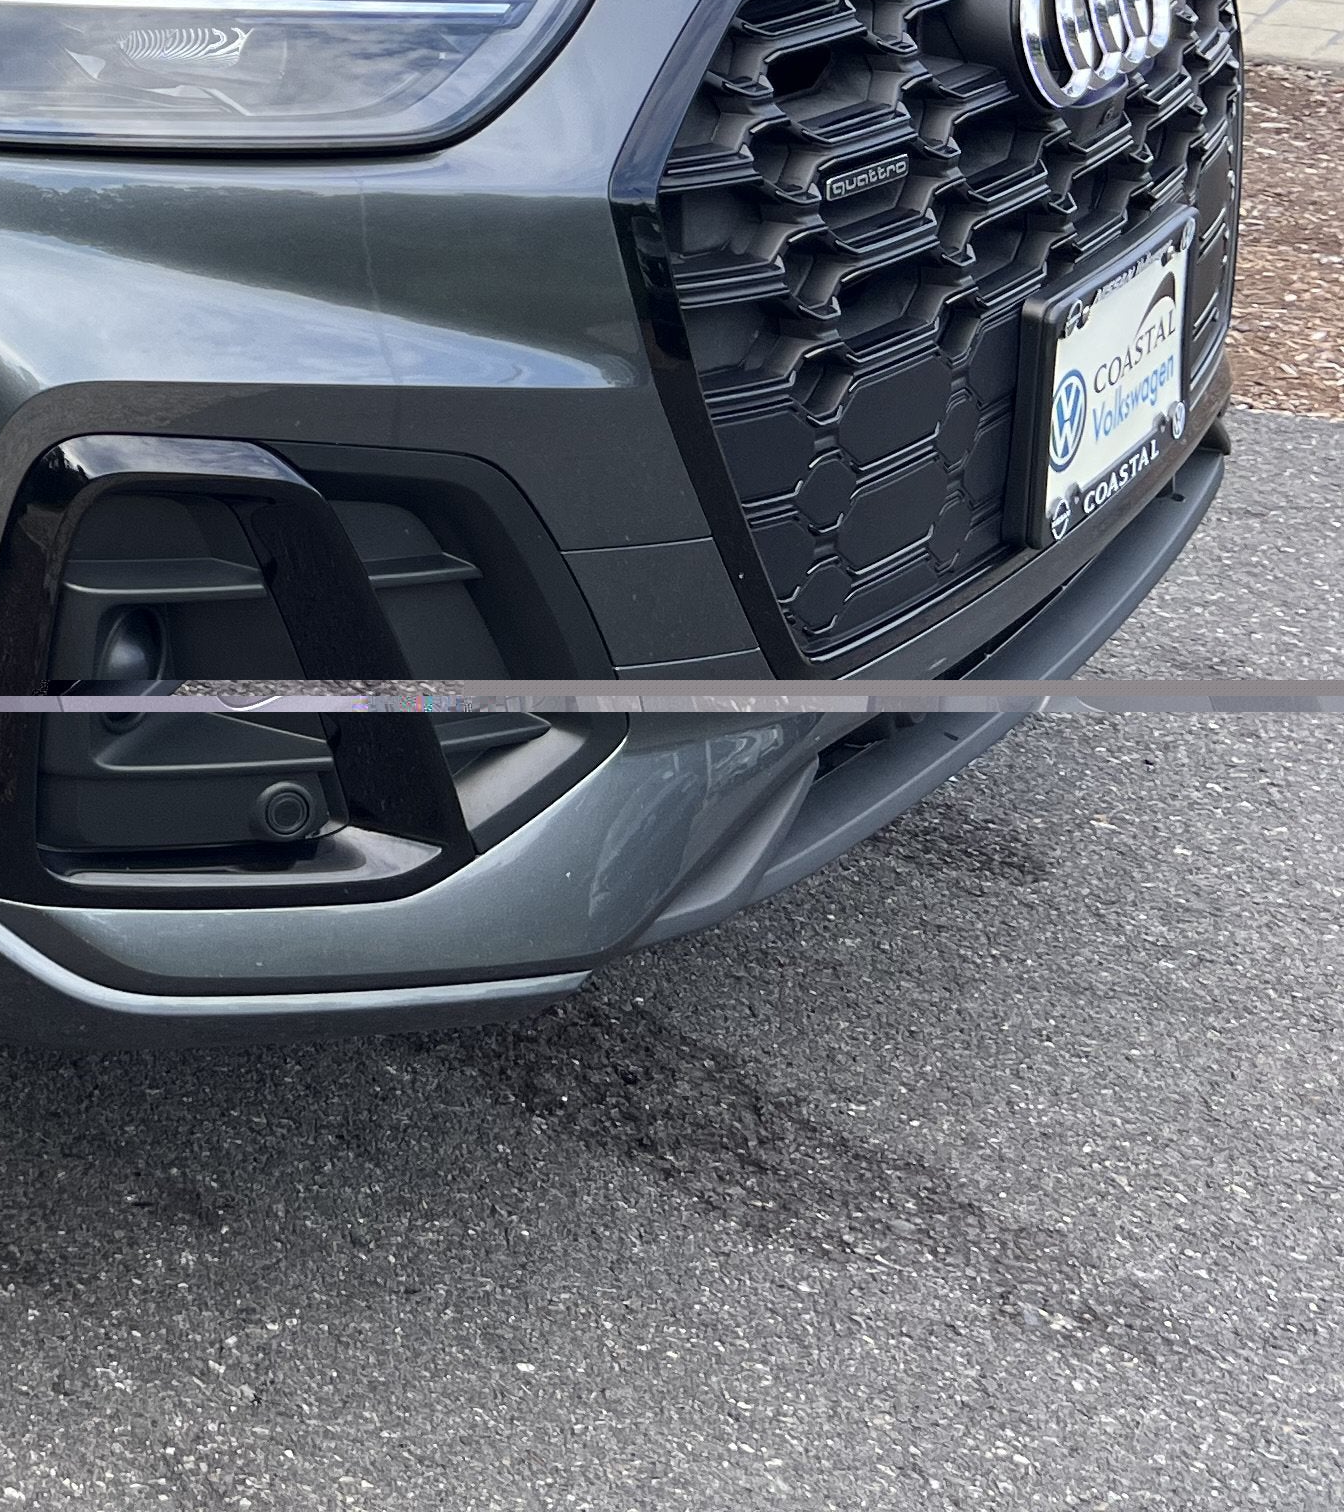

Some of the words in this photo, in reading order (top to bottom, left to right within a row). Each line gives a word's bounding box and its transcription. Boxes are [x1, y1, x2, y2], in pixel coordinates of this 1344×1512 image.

[831, 160, 908, 195] quattro
[1093, 310, 1176, 394] COASTAL
[1091, 354, 1174, 441] Volkswagen
[1083, 438, 1160, 514] COASTAL
